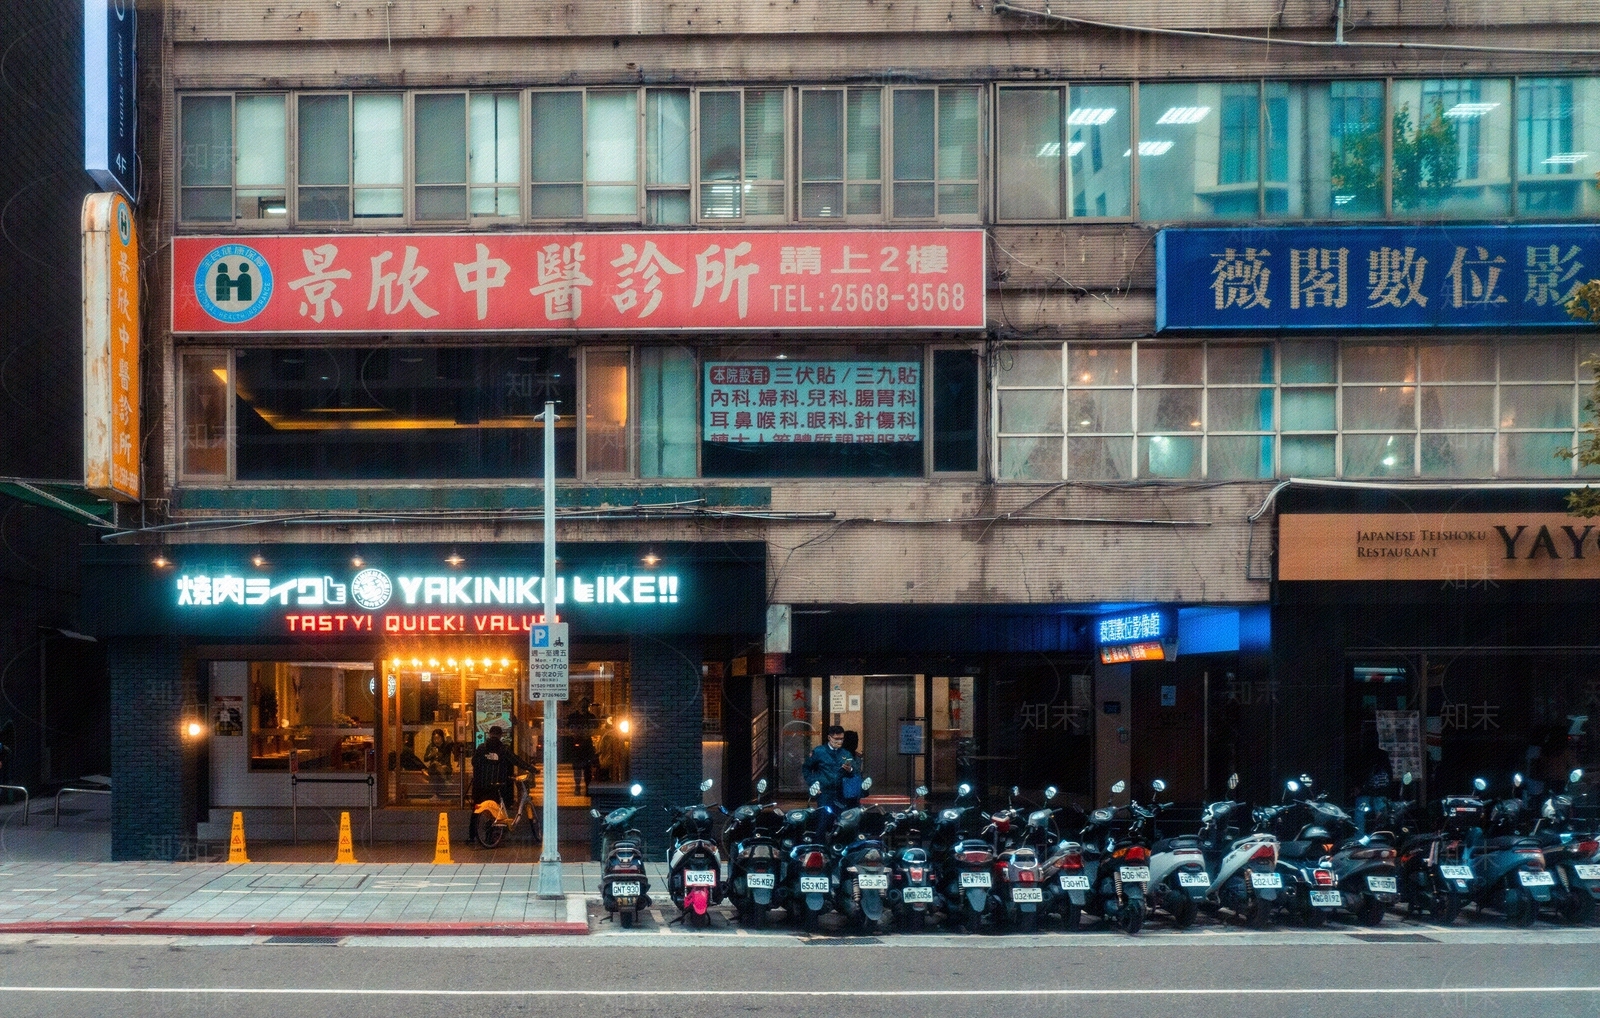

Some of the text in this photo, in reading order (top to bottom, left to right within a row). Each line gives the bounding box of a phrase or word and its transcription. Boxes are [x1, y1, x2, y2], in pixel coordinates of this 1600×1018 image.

[115, 153, 127, 174] 4F
[780, 244, 949, 275] 請上2樓
[287, 240, 760, 324] 景欣中醫診所
[1209, 244, 1585, 310] 薇閣數位影
[218, 312, 245, 320] HEALTH
[247, 282, 271, 317] INSURANCE
[769, 283, 966, 312] TEL:2568-3568
[117, 250, 133, 464] 景欣中醫診所
[1493, 524, 1600, 560] YAY
[286, 615, 372, 632] TASTY!
[385, 615, 464, 633] QUICK!
[534, 629, 546, 645] P
[531, 649, 567, 657] 週一至週五
[613, 884, 640, 895] GNT-930
[801, 881, 828, 891] 653-KDE
[1062, 880, 1088, 889] 730-HTL
